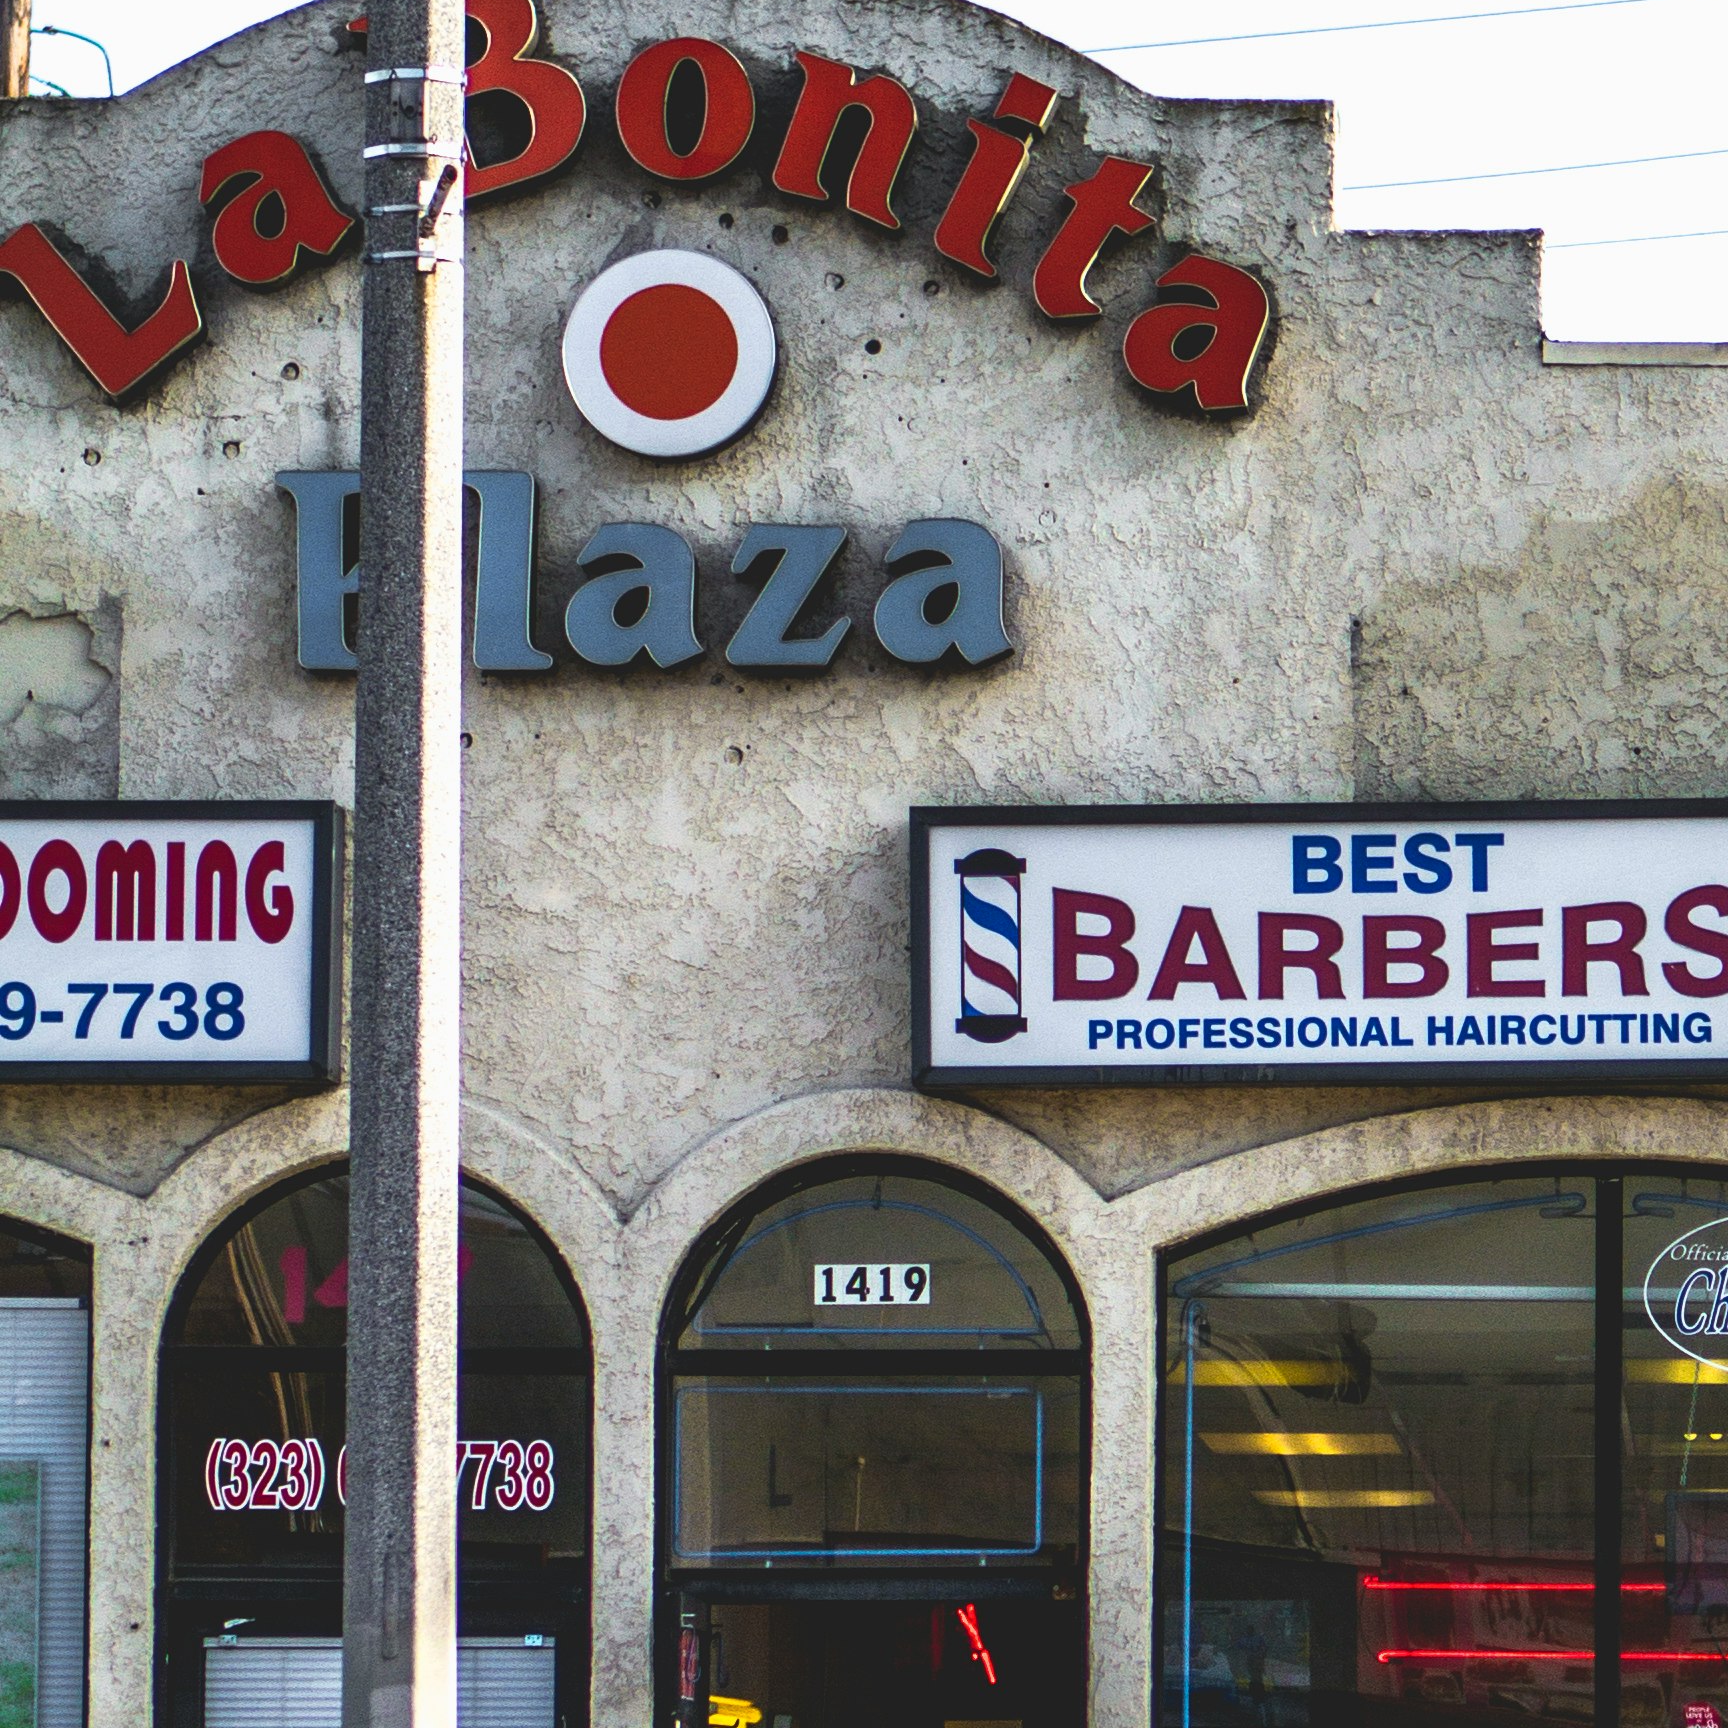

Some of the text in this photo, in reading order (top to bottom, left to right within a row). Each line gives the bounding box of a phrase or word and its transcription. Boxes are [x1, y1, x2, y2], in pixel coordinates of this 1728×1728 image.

[0, 129, 355, 396] La
[1291, 832, 1505, 896] BEST
[1087, 1012, 1713, 1051] PROFESSIONAL HAIRCUTTING
[821, 1266, 927, 1303] 1419
[206, 1438, 325, 1511] (323)
